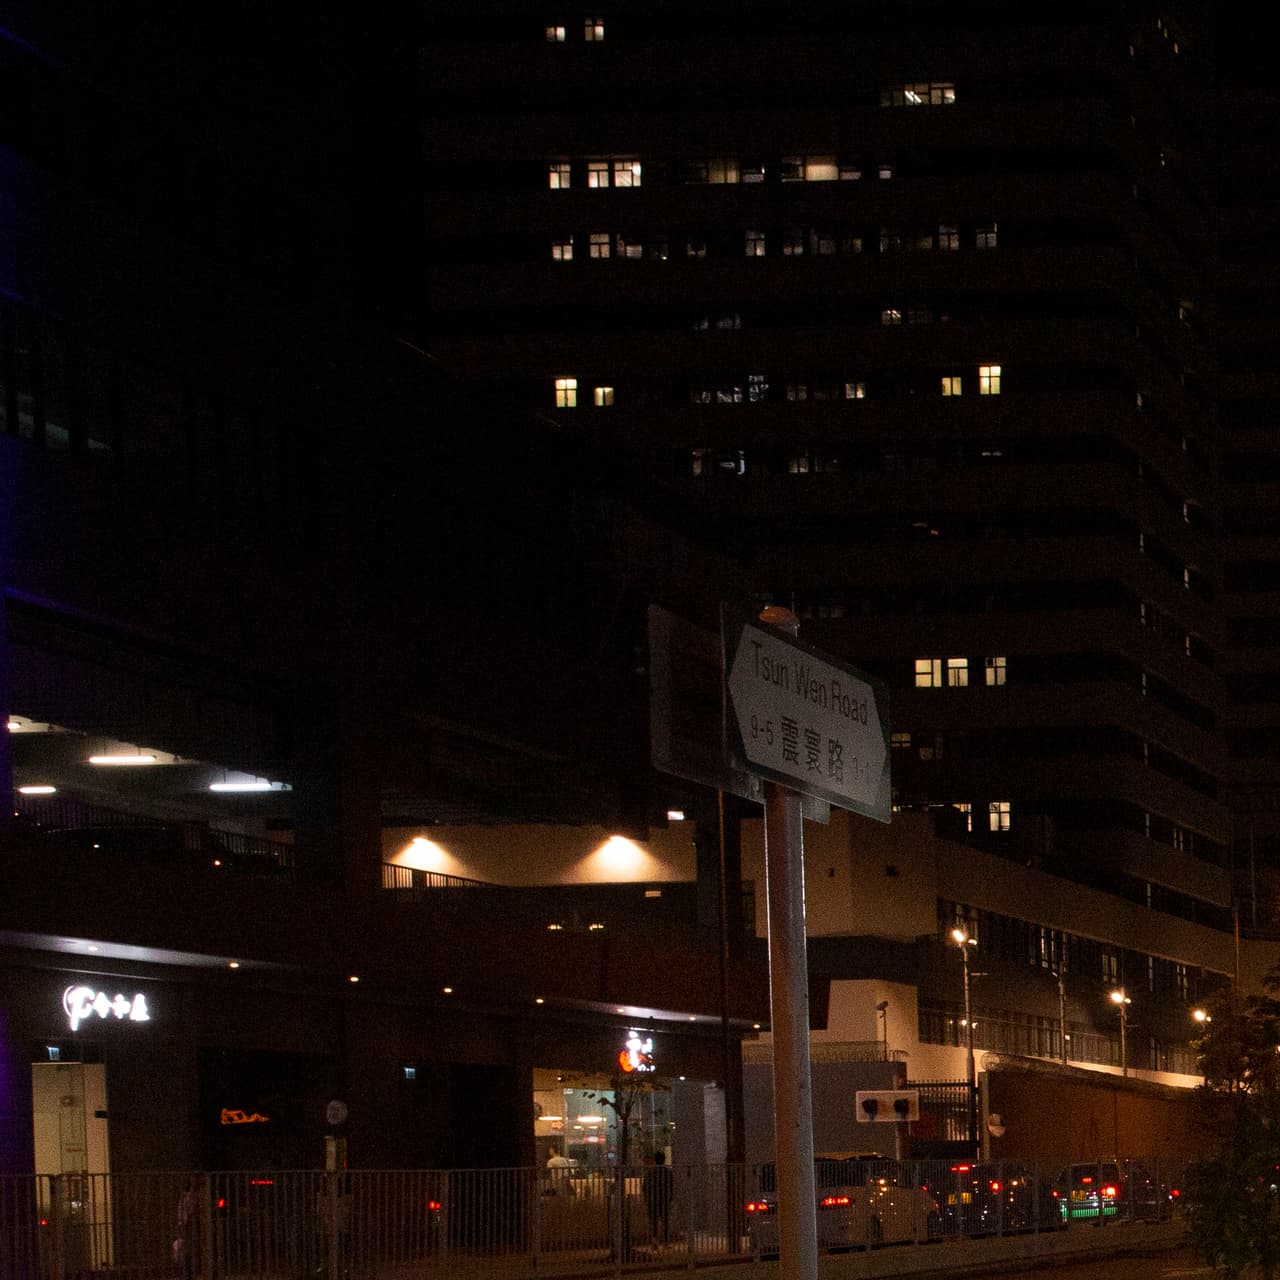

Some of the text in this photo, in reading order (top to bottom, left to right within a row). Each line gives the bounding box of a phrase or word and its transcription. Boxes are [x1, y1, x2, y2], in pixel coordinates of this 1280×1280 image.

[751, 640, 869, 727] Tsun Wen Road
